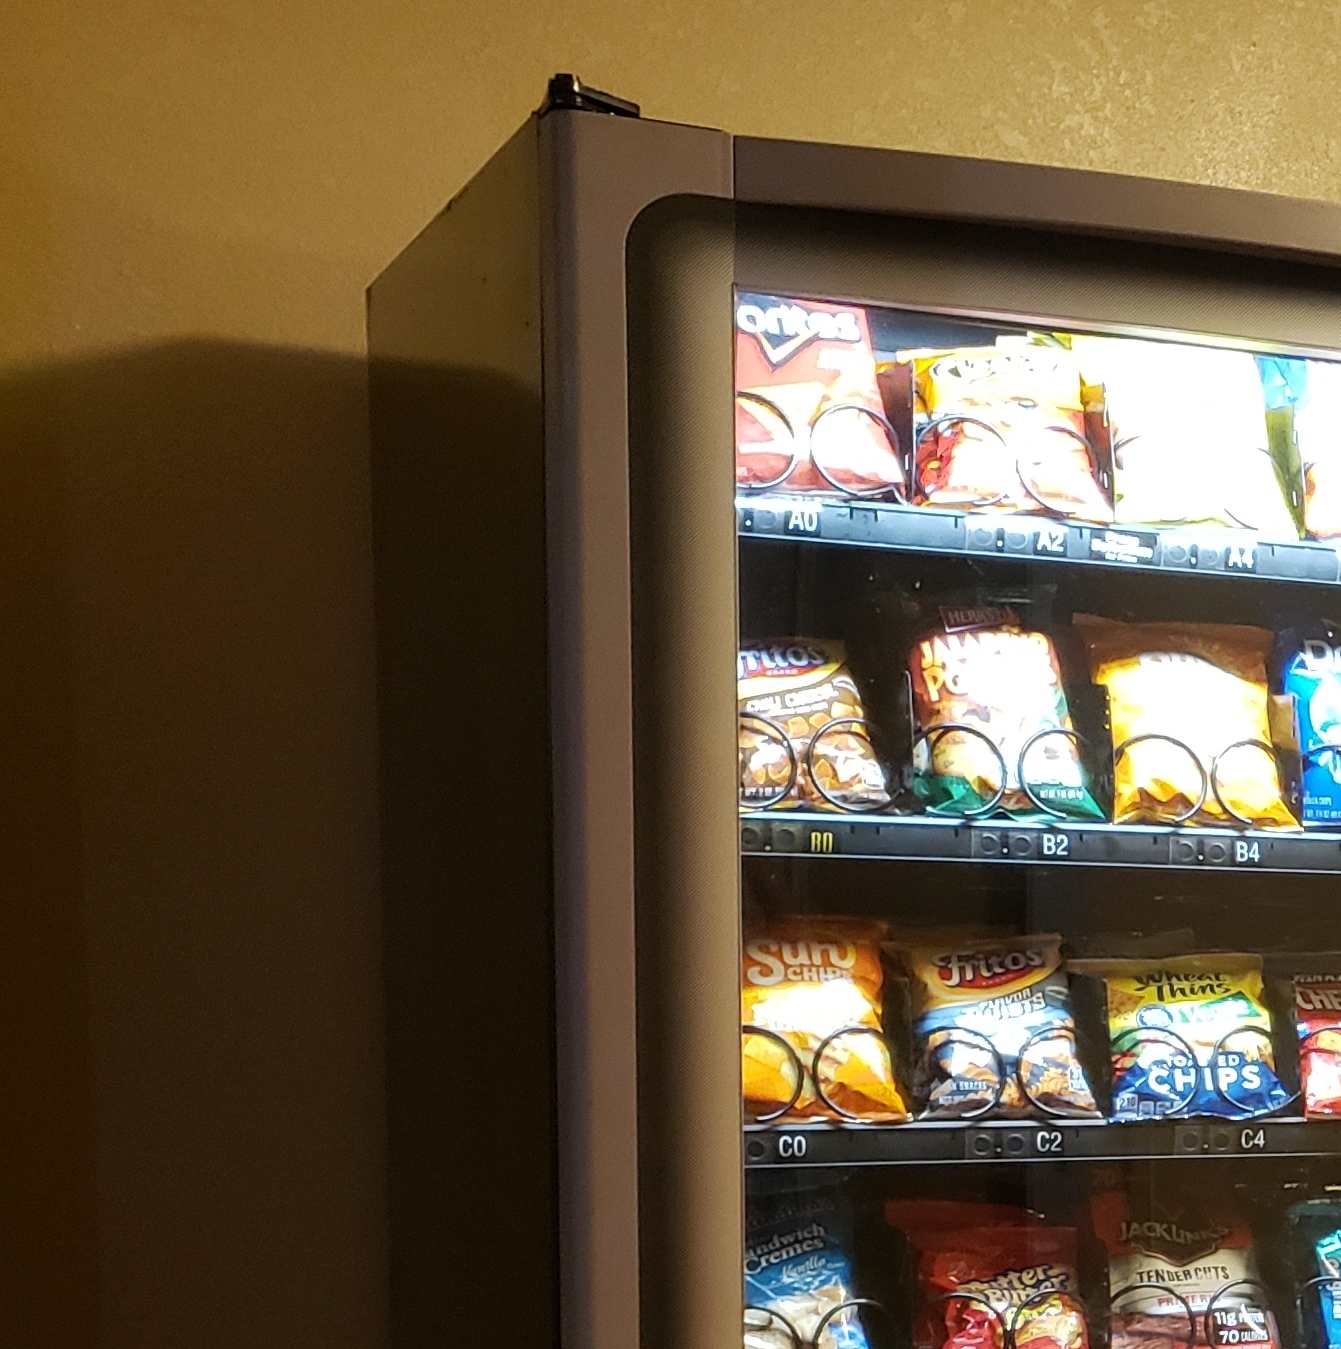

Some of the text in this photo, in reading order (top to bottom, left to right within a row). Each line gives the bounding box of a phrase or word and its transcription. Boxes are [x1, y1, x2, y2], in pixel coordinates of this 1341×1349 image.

[737, 304, 861, 342] oritos
[788, 508, 818, 533] A0
[1036, 530, 1065, 553] A2
[1228, 548, 1255, 572] A4
[1042, 834, 1069, 856] B2
[1235, 842, 1260, 863] B4
[931, 949, 1046, 988] Fritos
[1135, 982, 1232, 1002] Thins
[1147, 1064, 1262, 1092] CHIPS
[778, 1136, 807, 1158] C0
[1036, 1131, 1063, 1153] C2
[1241, 1129, 1266, 1150] C4
[743, 1236, 825, 1275] Cremes
[1136, 1265, 1231, 1285] TENDER CUTS
[1213, 1311, 1238, 1326] 11g
[1219, 1329, 1240, 1345] 70
